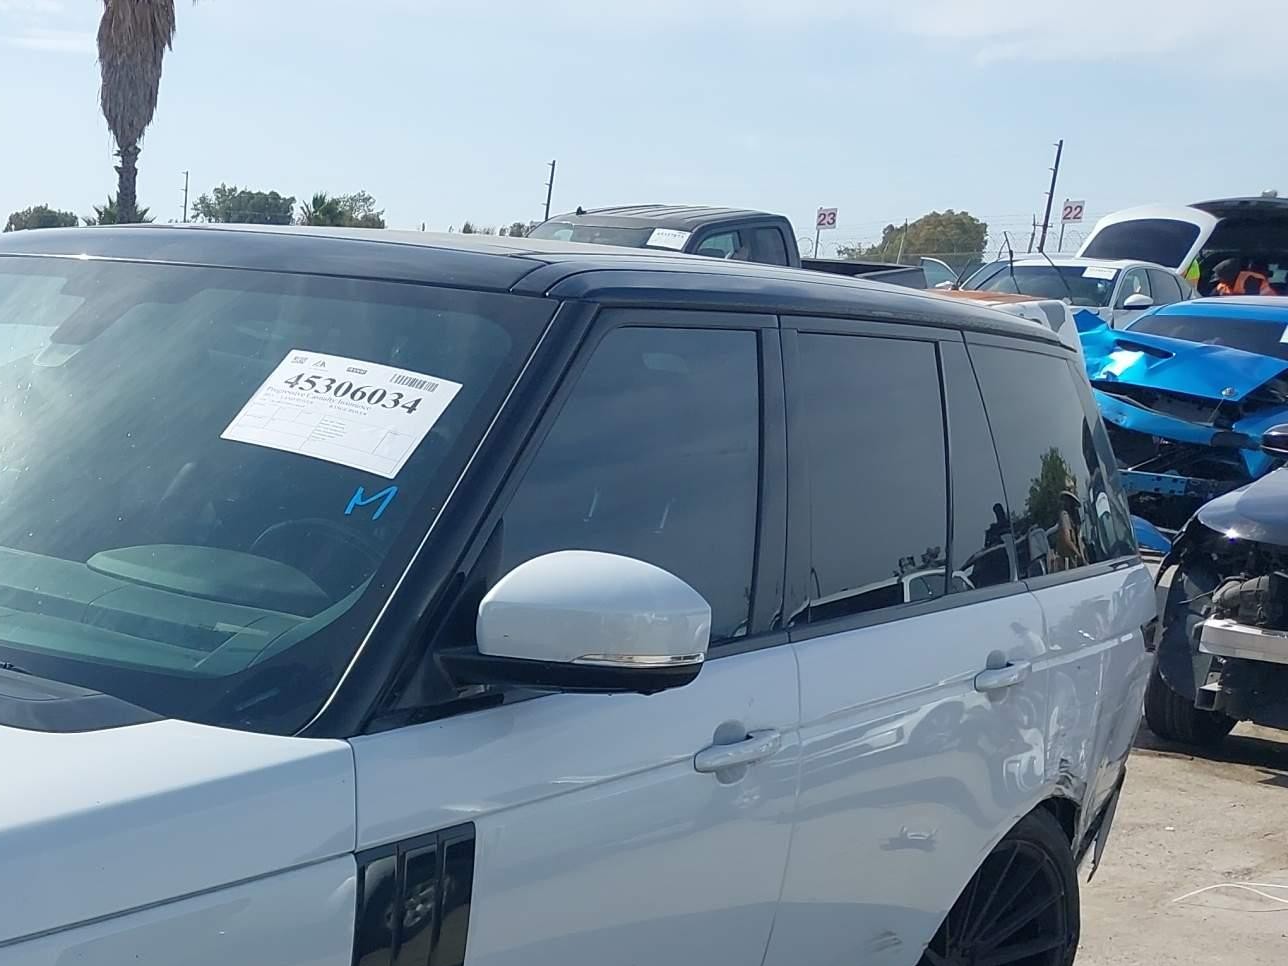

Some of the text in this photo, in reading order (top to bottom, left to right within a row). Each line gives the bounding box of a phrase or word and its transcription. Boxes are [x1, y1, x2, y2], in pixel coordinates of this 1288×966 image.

[817, 212, 837, 226] 23
[1063, 205, 1083, 220] 22
[283, 372, 423, 414] 45306034
[344, 486, 398, 520] M
